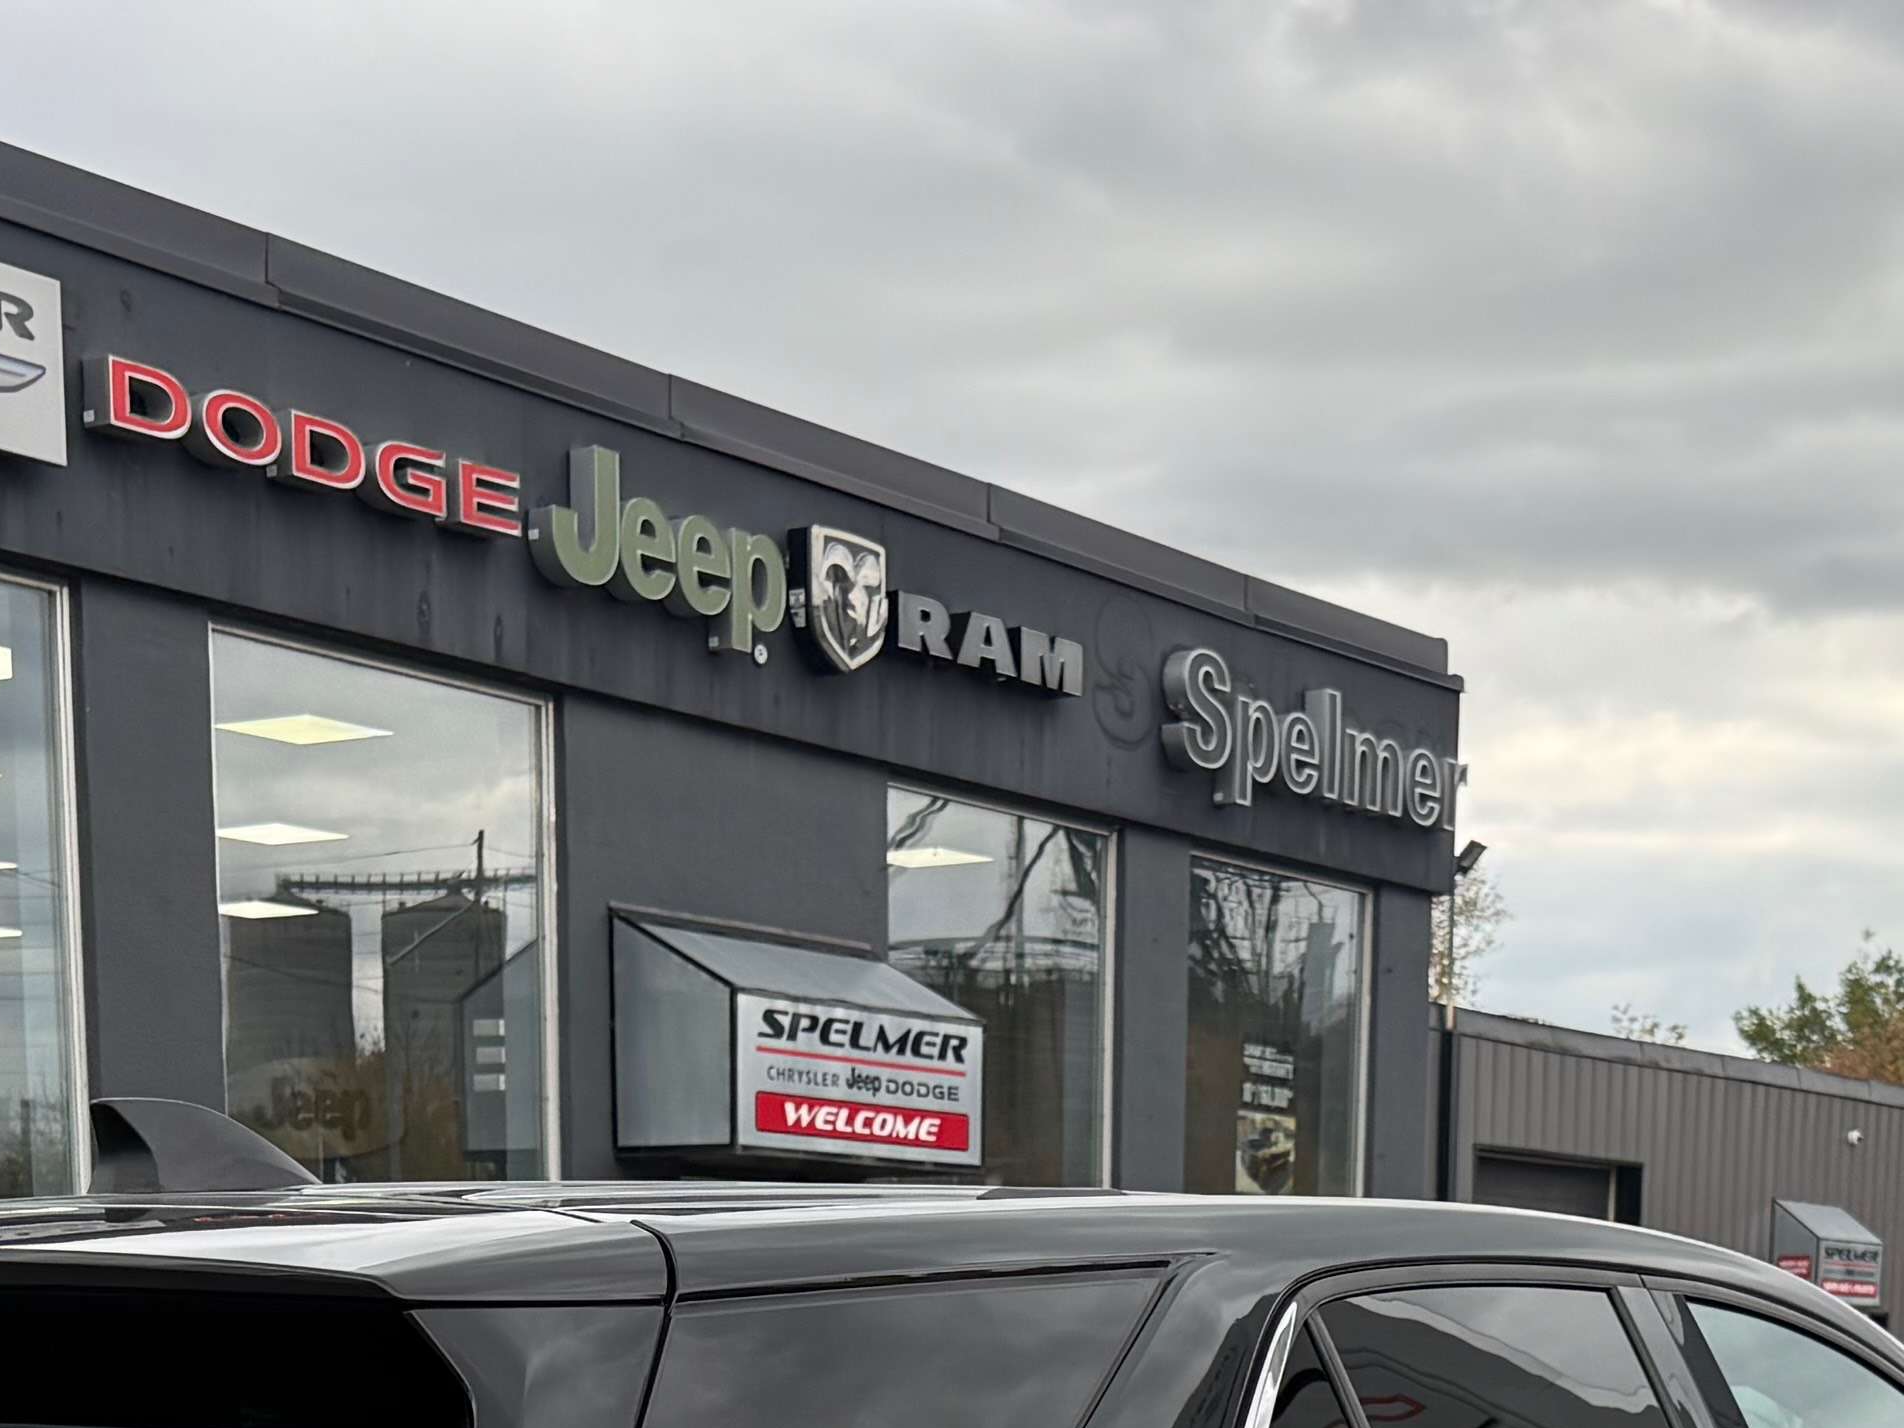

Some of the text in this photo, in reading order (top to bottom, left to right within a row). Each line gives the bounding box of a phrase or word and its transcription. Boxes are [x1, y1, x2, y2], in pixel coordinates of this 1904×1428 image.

[104, 353, 522, 537] DODGE
[532, 445, 785, 655] Jeep
[893, 594, 1084, 698] RAM
[1166, 646, 1468, 831] Spelmer
[757, 1008, 968, 1065] SPELMER
[767, 1065, 960, 1102] CHRYSLER Jeep DODGE
[784, 1101, 942, 1142] WELCOME
